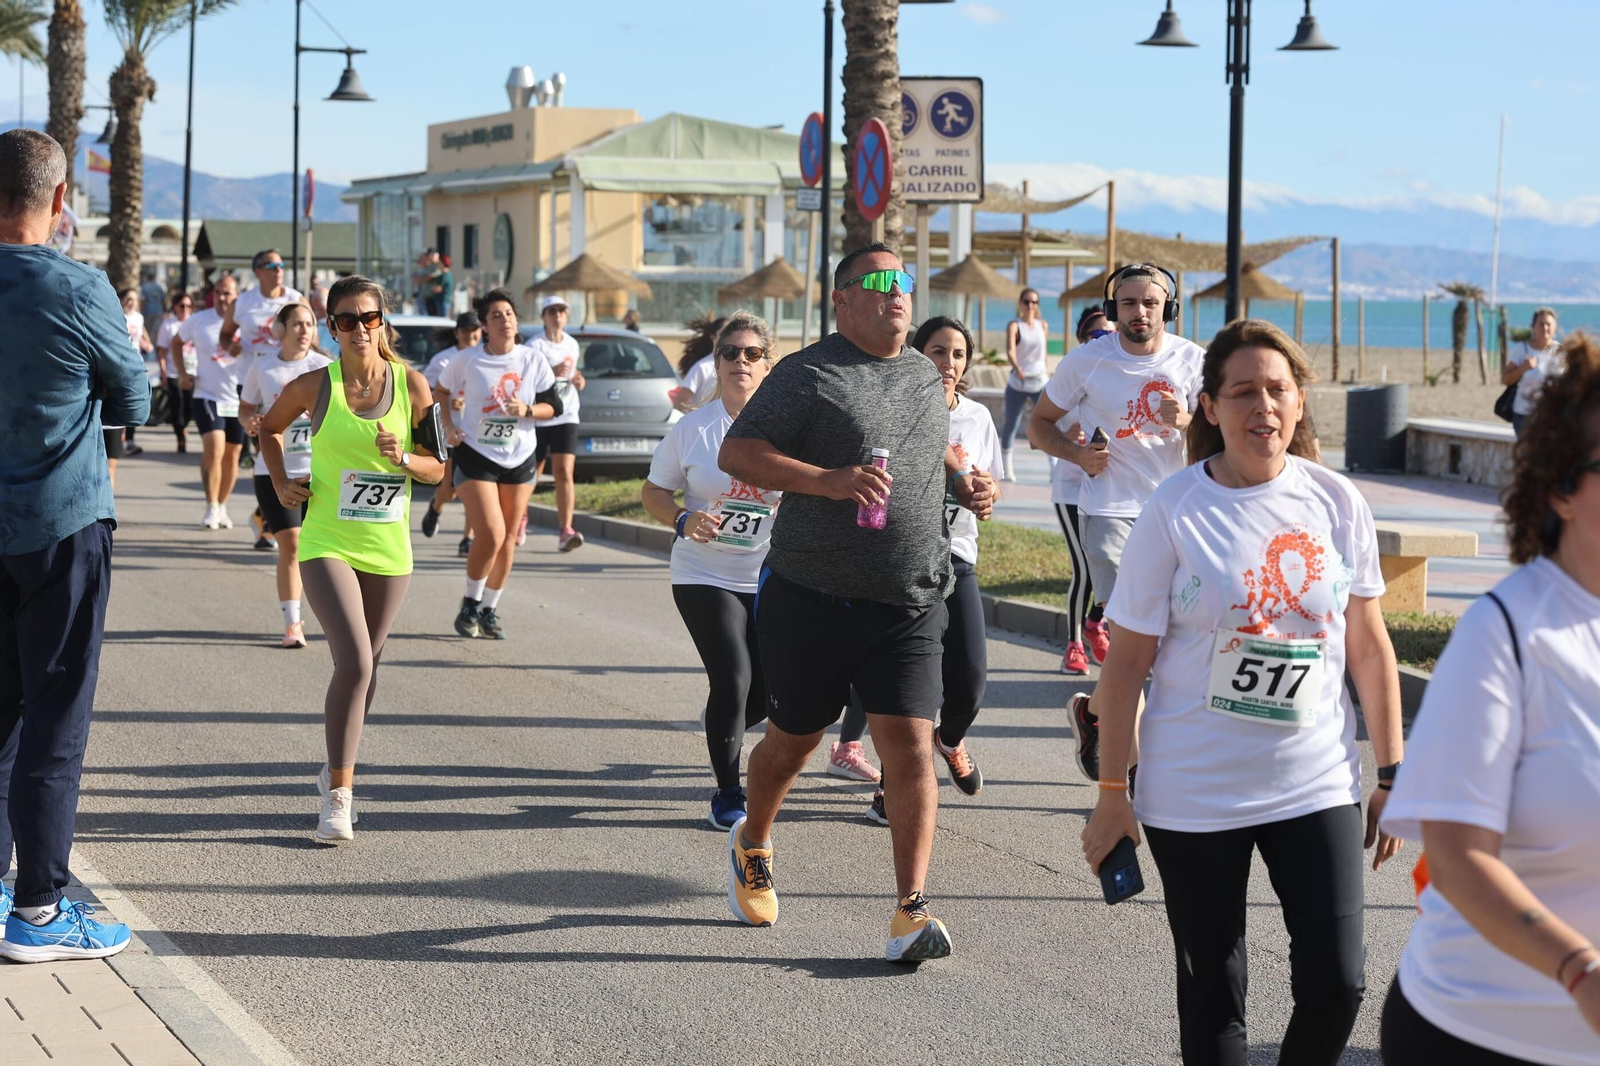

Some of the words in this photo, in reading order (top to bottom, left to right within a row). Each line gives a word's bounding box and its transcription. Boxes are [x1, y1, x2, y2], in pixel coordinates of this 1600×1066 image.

[901, 149, 920, 157] TAS
[935, 149, 970, 157] PATINES
[908, 165, 968, 177] CARRIL
[484, 423, 515, 438] 733
[351, 483, 401, 506] 737
[718, 510, 762, 535] 731
[1231, 657, 1311, 699] 517
[1213, 698, 1232, 710] 024
